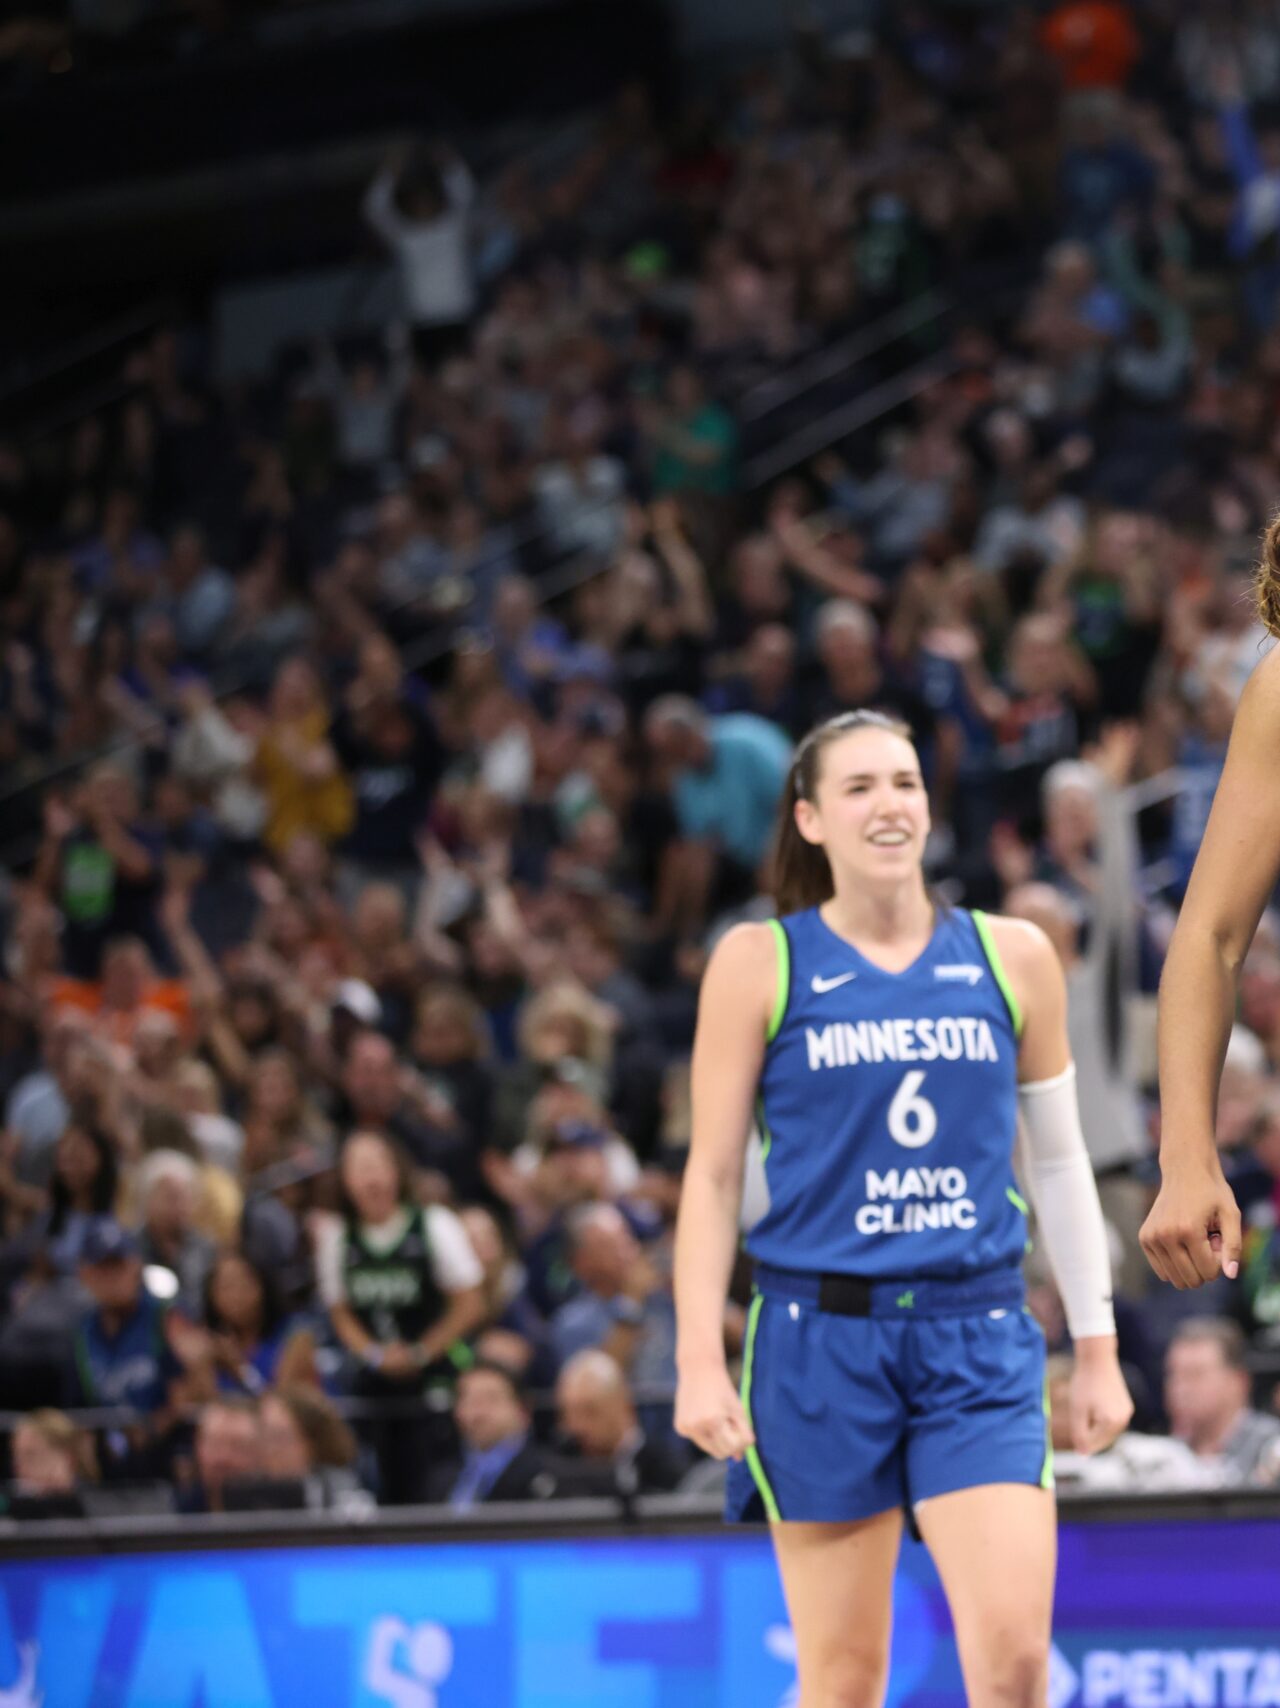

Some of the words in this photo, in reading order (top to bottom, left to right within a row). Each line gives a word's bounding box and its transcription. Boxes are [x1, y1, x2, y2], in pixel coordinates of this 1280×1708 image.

[806, 1017, 998, 1071] MINNESOTA
[887, 1070, 937, 1148] 6
[866, 1167, 967, 1200] MAYO
[855, 1198, 977, 1235] CLINIC
